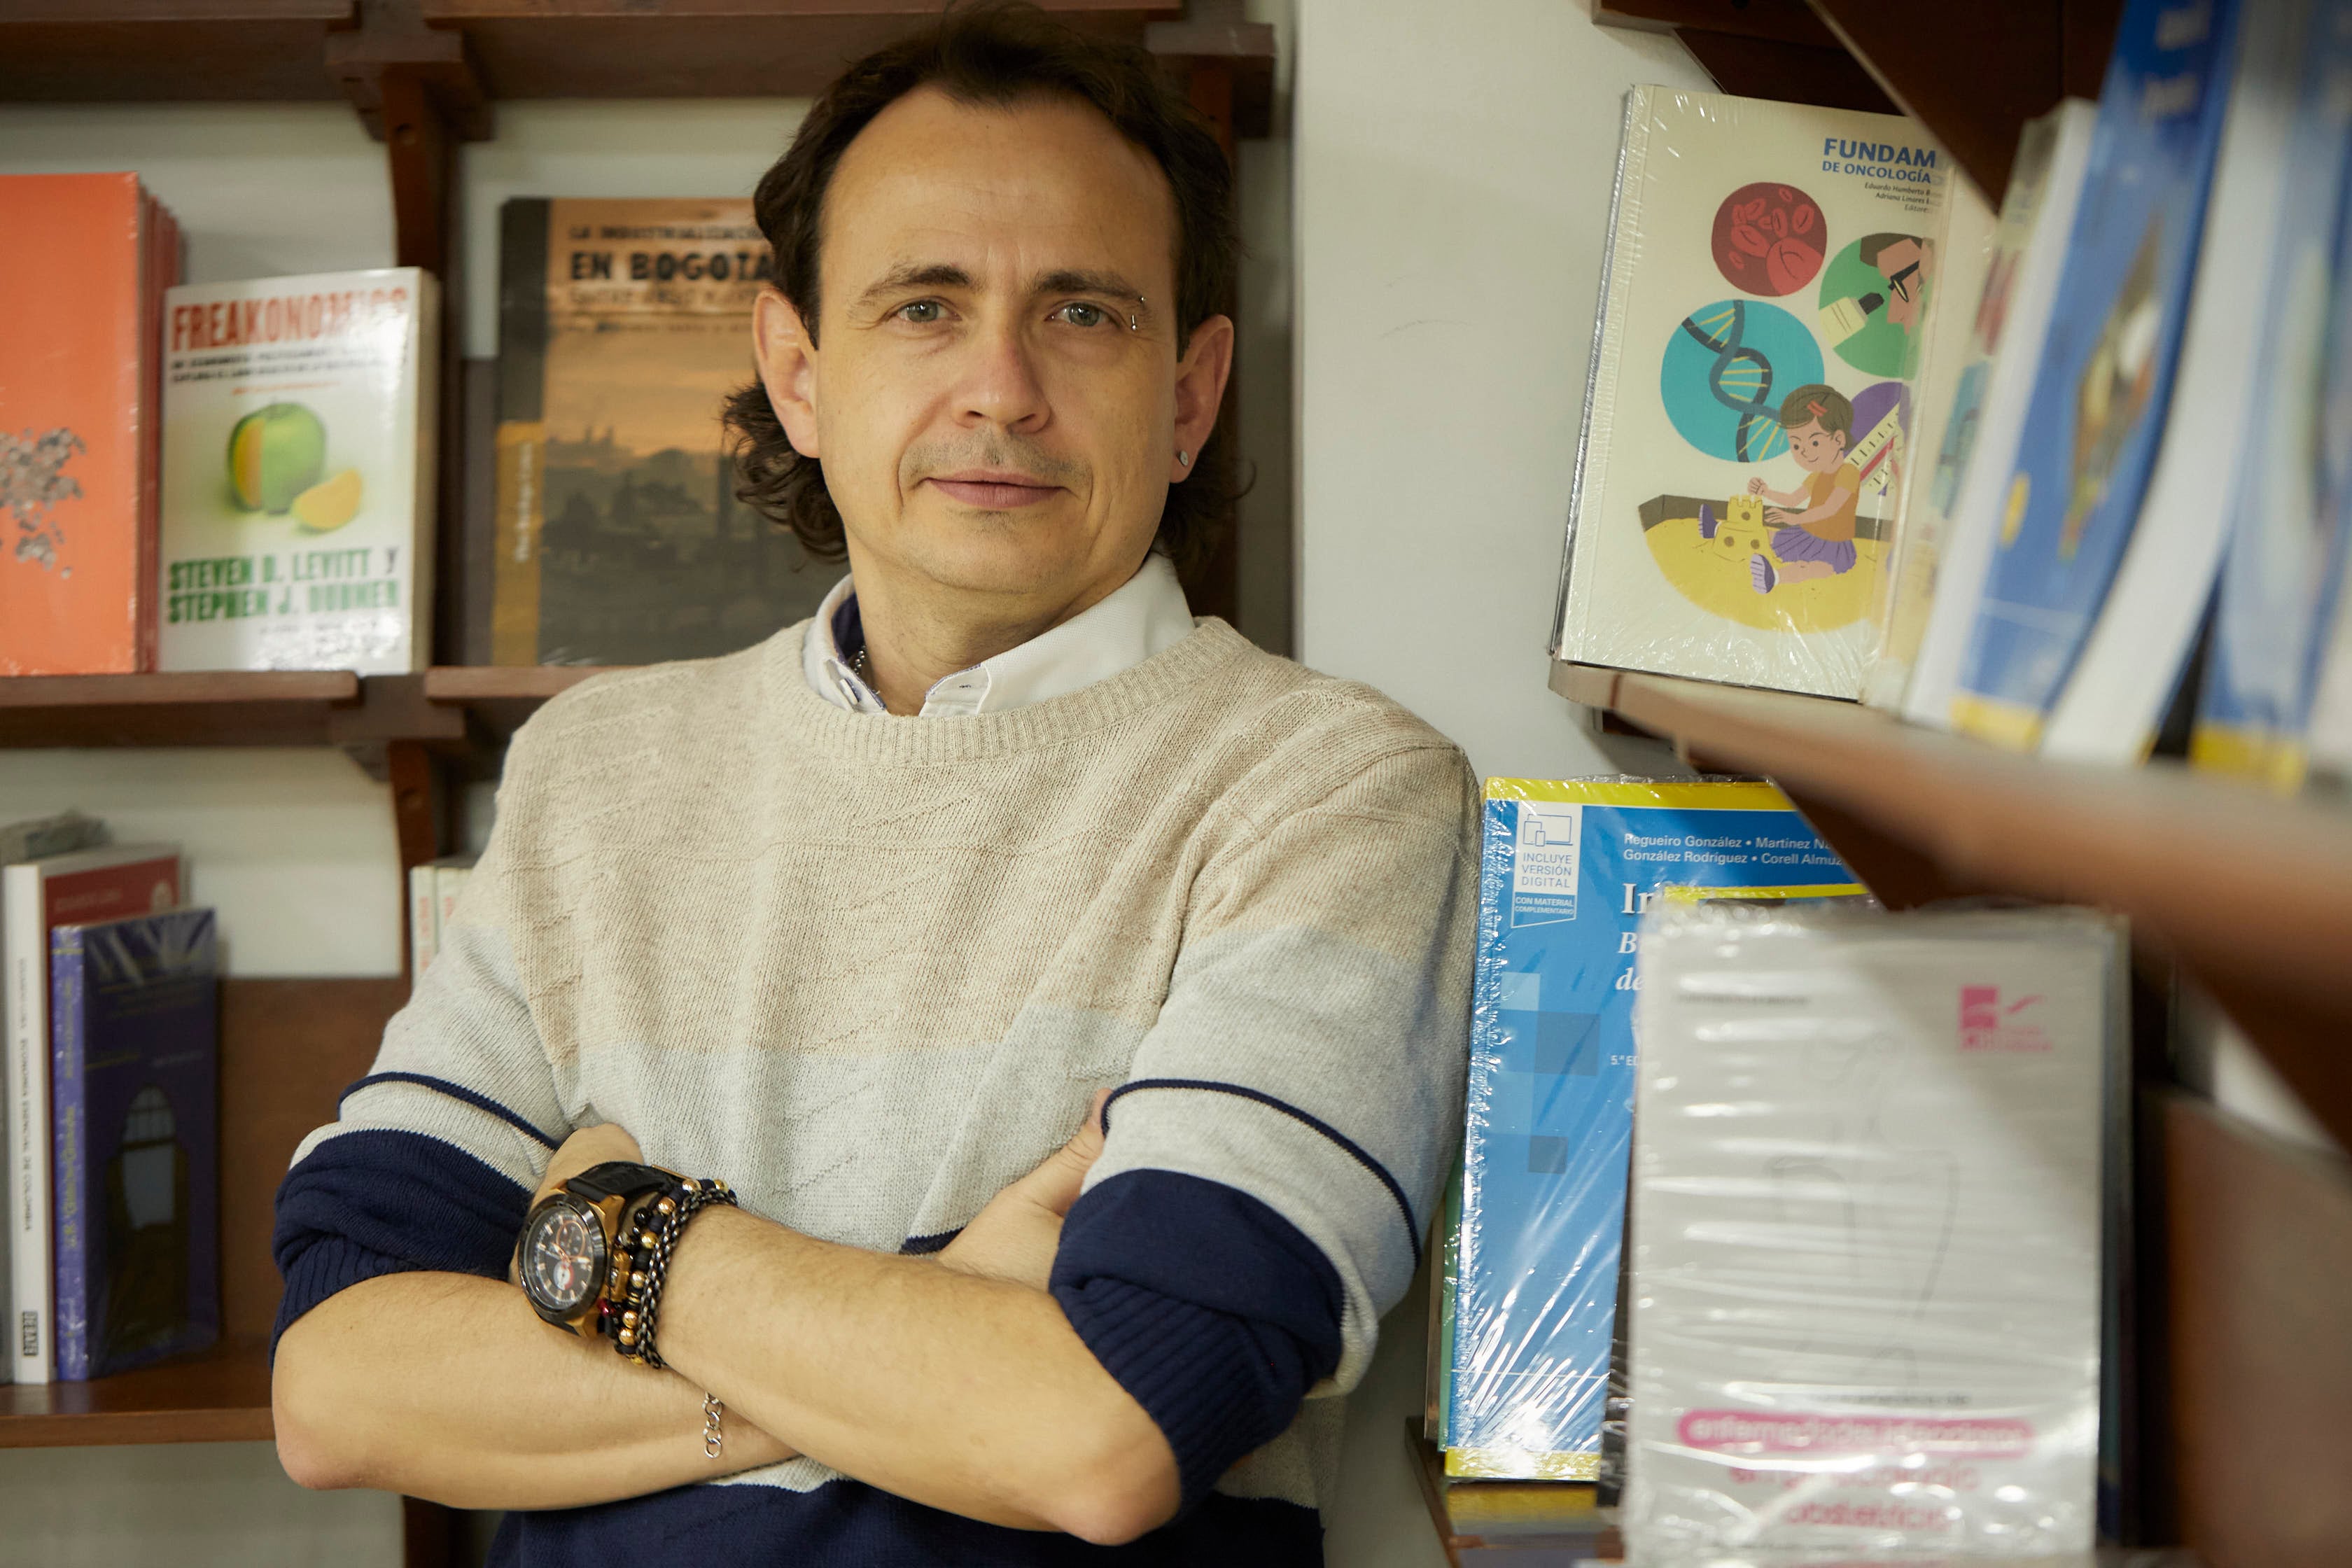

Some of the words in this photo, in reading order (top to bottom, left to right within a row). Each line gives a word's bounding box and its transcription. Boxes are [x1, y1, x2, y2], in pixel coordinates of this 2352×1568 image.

[1823, 138, 1936, 169] FUNDAM
[1822, 161, 1840, 173] DE
[1844, 163, 1932, 183] ONCOLOGÍA
[1864, 182, 1891, 192] Eduardo
[1893, 186, 1924, 196] Humberto
[1876, 192, 1900, 202] Adriana
[1901, 195, 1924, 204] Linares
[571, 252, 612, 279] EN
[172, 288, 408, 352] FREAKONO
[293, 548, 372, 582] LEVITT
[1624, 833, 1681, 848] Regueiro
[1685, 834, 1742, 848] González
[1755, 836, 1810, 849] Martínez
[1523, 853, 1572, 864] INCLUYE
[1623, 848, 1680, 862] González
[1684, 850, 1747, 864] Rodríguez
[1761, 852, 1798, 864] Corell
[1522, 864, 1572, 876] VERSIÓN
[1521, 876, 1570, 888] DIGITAL
[1534, 897, 1574, 907] MATERIAL
[1514, 906, 1574, 915] COMPLEMENTARIO
